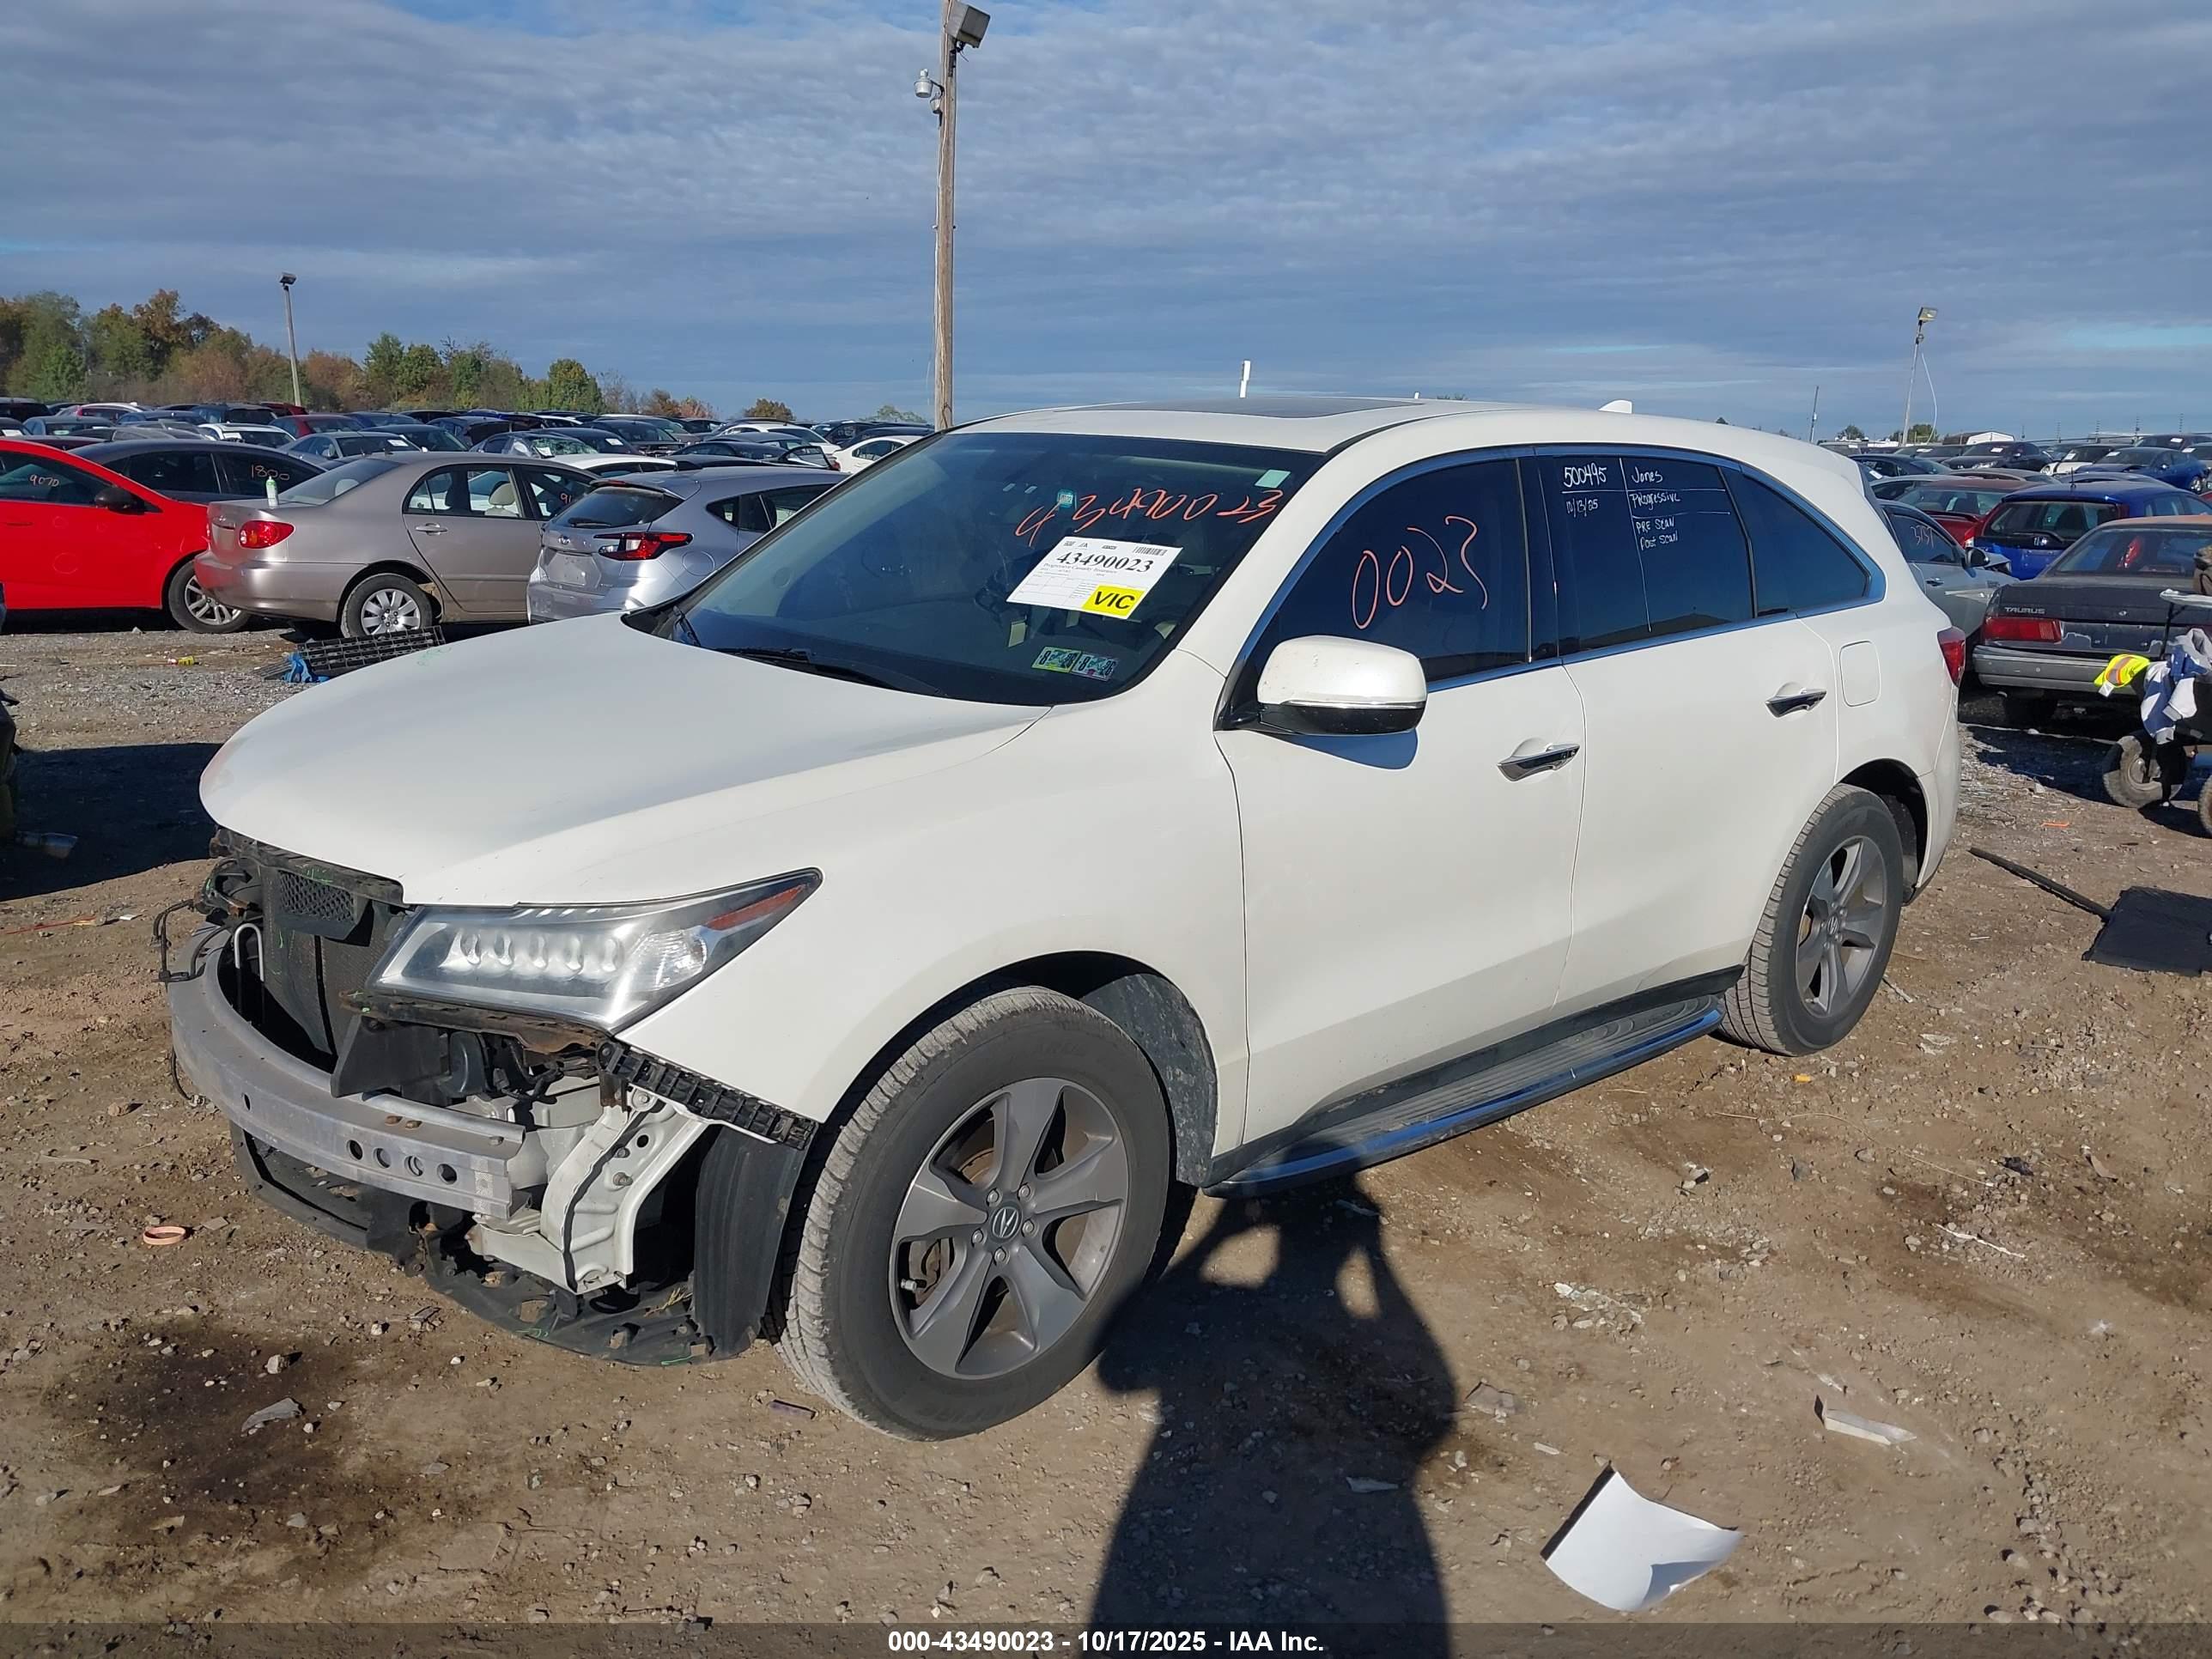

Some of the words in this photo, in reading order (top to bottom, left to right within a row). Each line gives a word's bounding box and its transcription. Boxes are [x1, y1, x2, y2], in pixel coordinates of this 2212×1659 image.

[1563, 462, 1607, 488] 500495
[1631, 466, 1663, 483] Jones
[1636, 520, 1651, 534] PRE
[1057, 551, 1154, 574] 43490023
[1352, 515, 1489, 630] 0023
[1094, 590, 1135, 610] VIC
[2003, 606, 2046, 615] TAURUS
